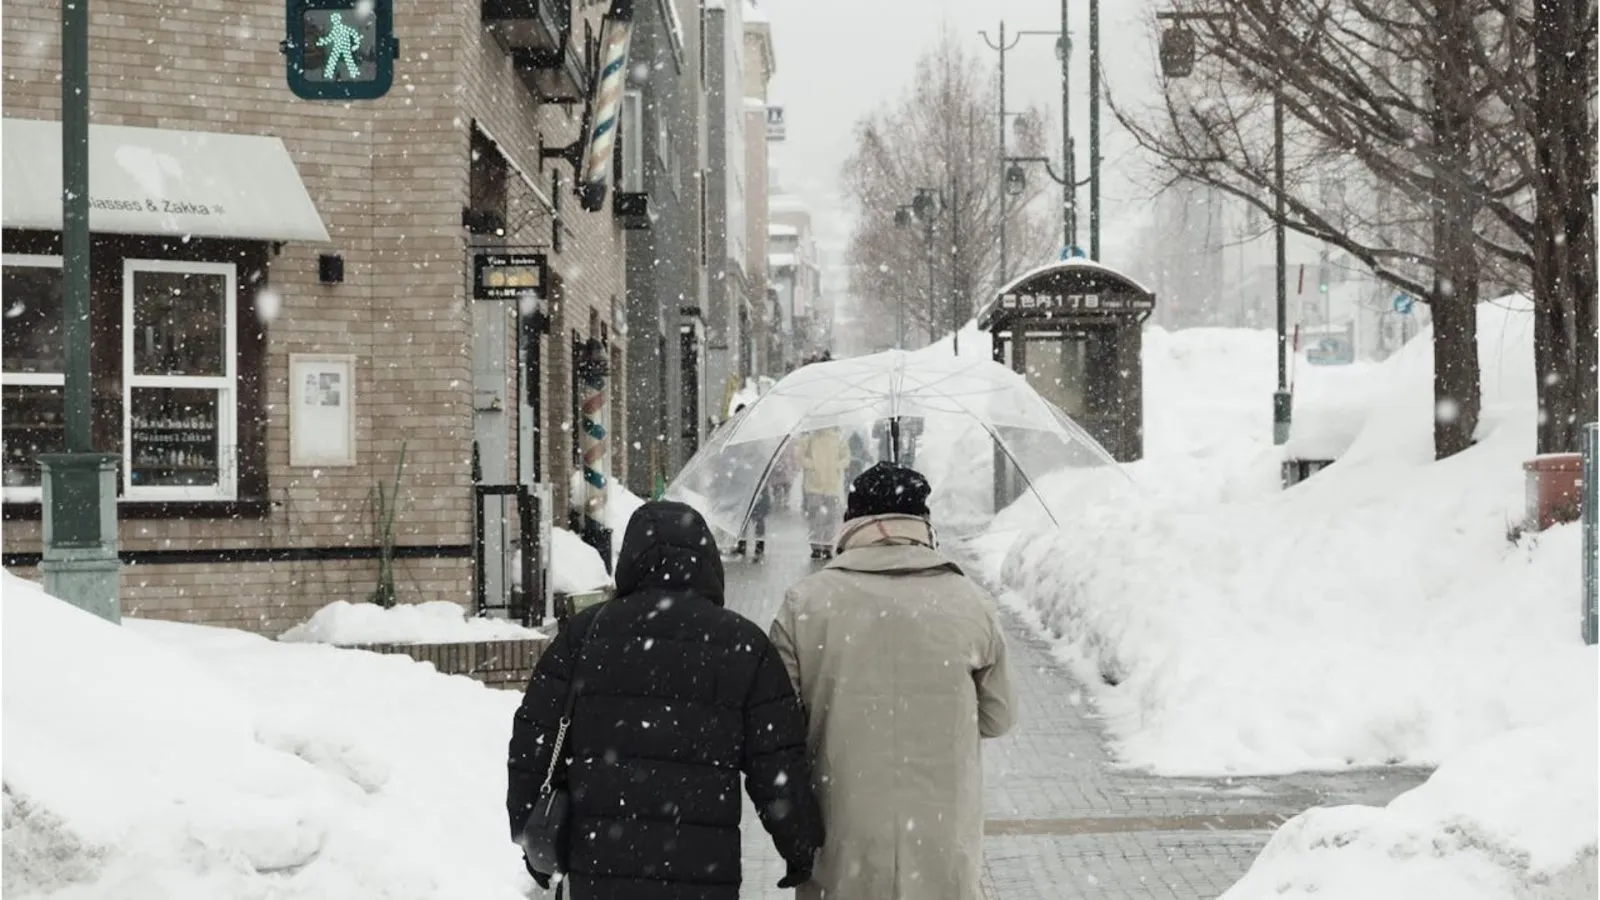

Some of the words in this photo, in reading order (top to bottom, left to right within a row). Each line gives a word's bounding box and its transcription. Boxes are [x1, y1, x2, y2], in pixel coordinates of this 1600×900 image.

[88, 197, 143, 212] lasses
[146, 198, 158, 213] &
[161, 200, 210, 216] Zakka
